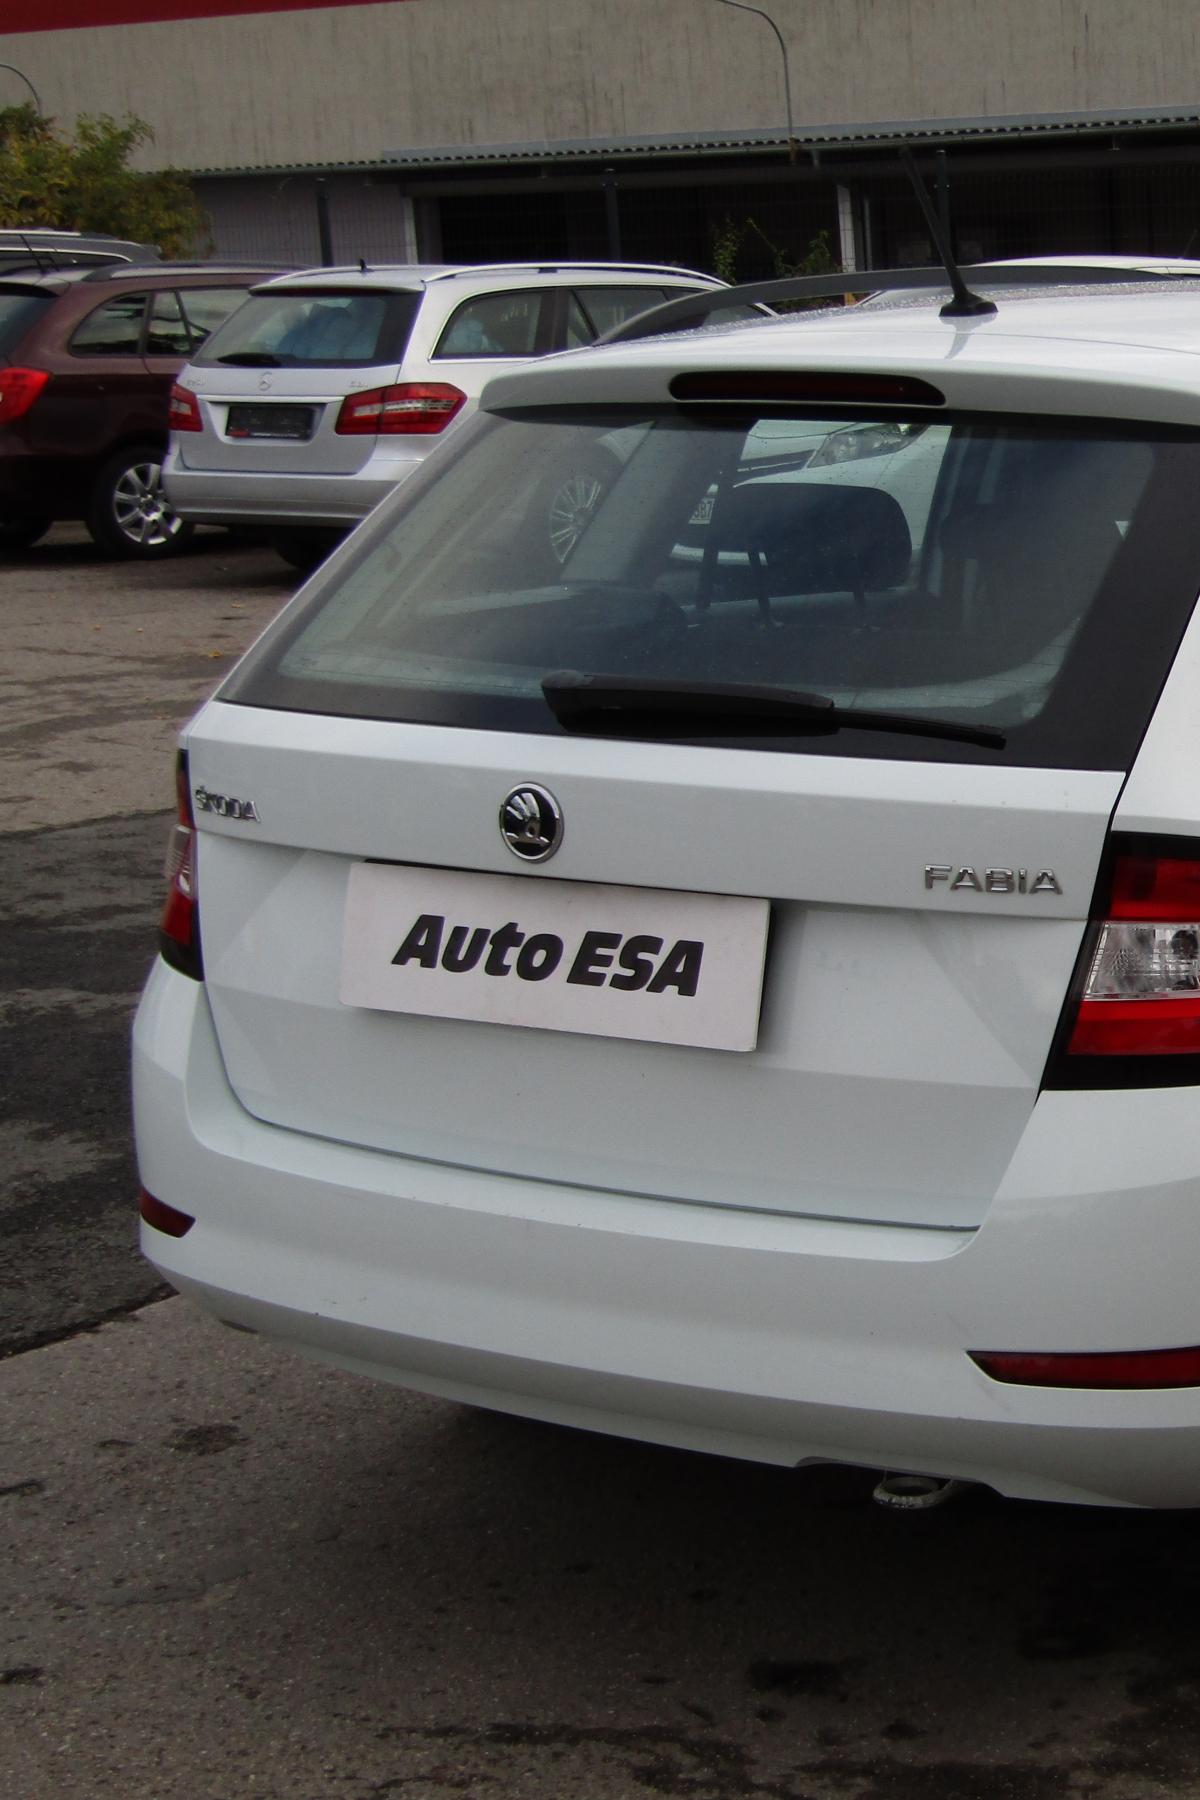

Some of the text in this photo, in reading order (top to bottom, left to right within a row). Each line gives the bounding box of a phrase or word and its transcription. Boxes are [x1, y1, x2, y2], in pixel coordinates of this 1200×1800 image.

[924, 864, 1063, 895] FABIA
[391, 914, 705, 997] Auto ESA
